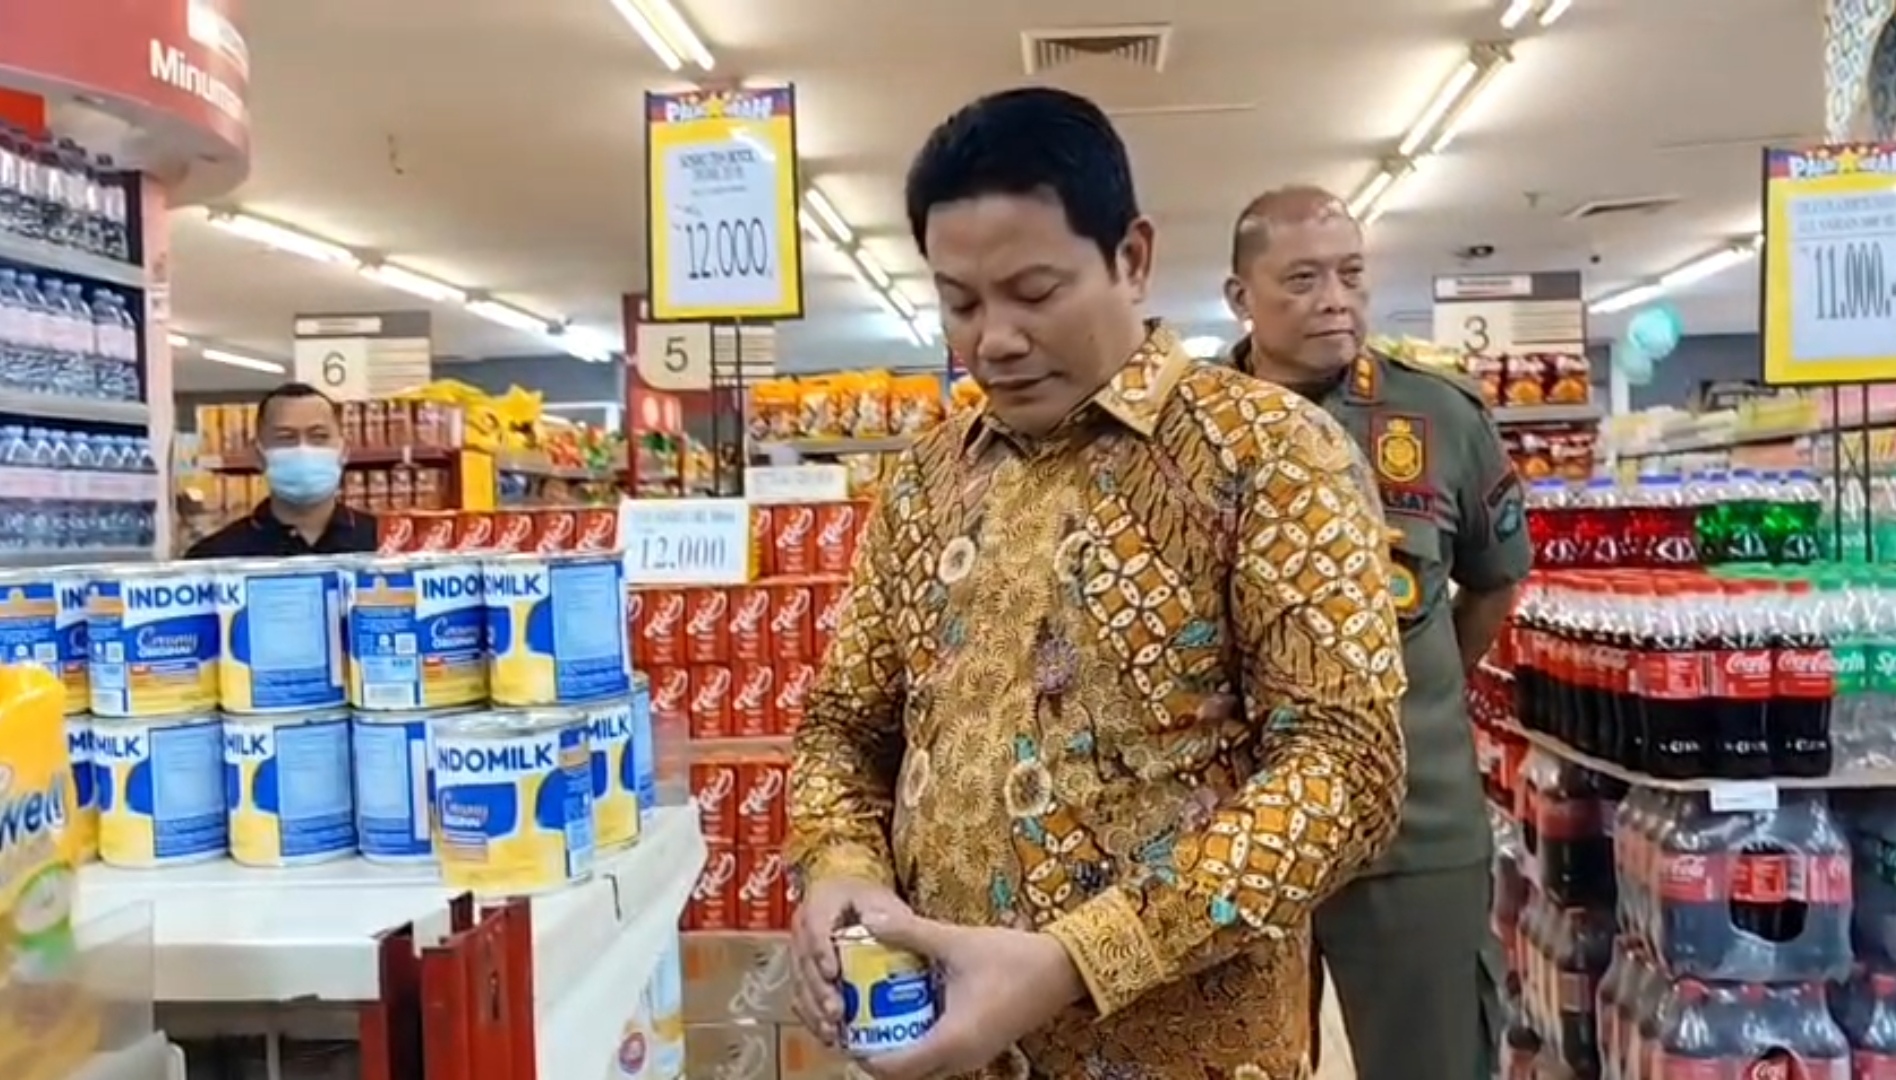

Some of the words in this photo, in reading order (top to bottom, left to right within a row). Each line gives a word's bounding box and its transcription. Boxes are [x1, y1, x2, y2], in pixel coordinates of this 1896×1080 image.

[1464, 315, 1489, 352] 3
[323, 351, 346, 386] 6
[664, 336, 688, 372] 5
[588, 713, 630, 741] MILK
